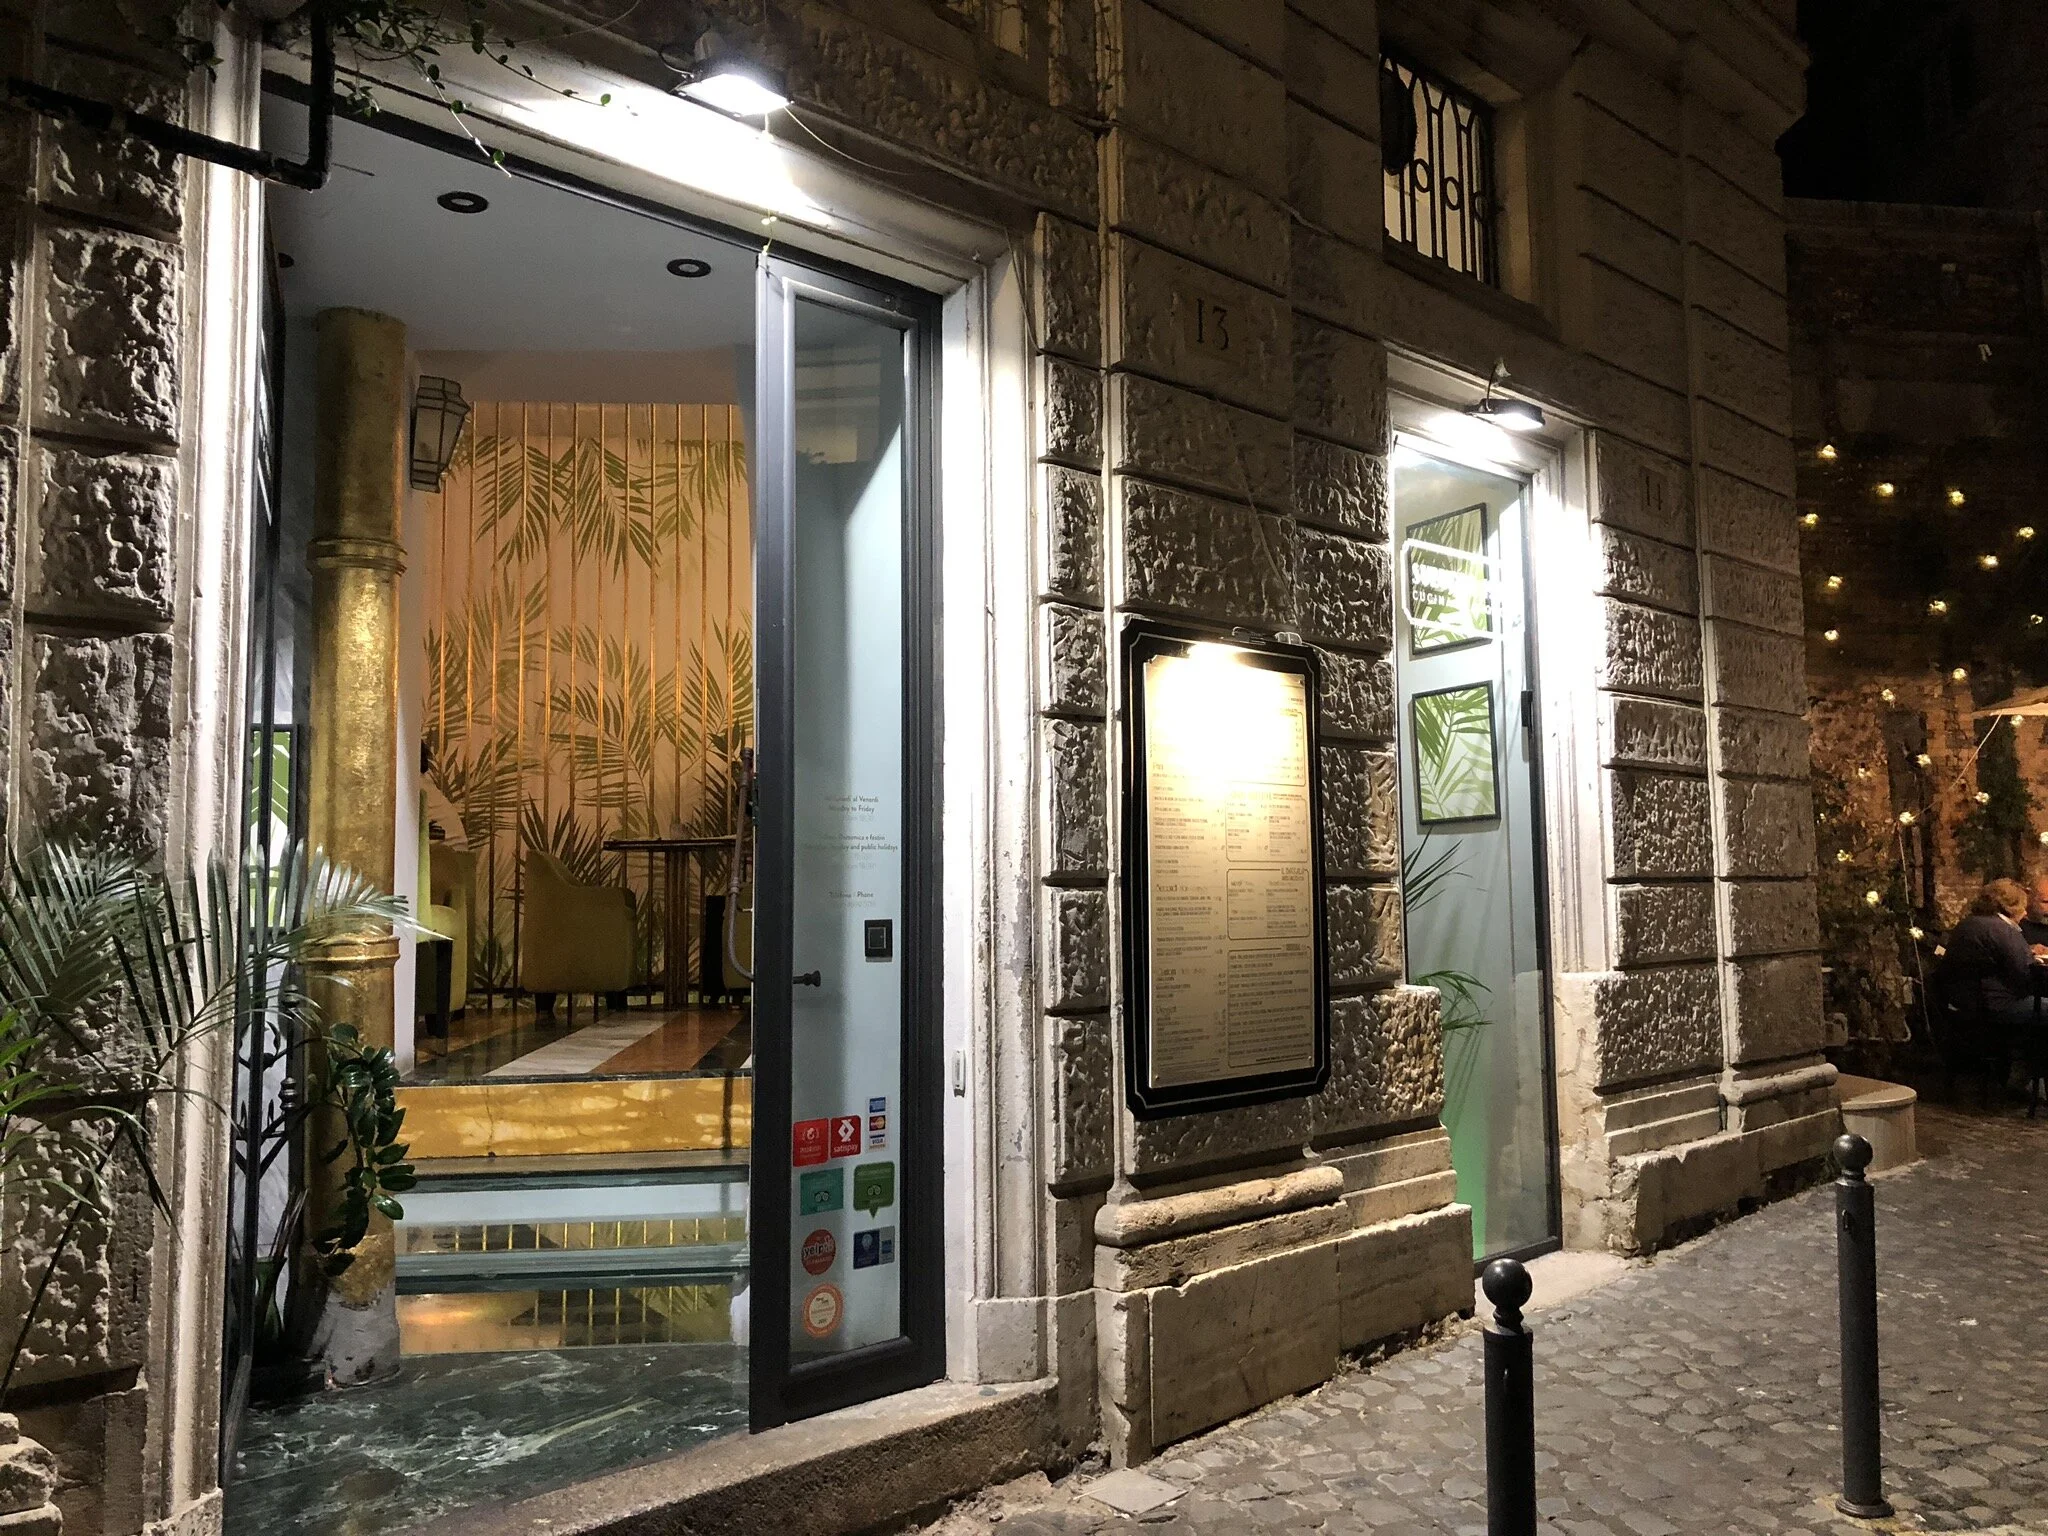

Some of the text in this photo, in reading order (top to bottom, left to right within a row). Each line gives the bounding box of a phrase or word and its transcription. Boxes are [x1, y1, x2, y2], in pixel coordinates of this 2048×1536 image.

[1196, 297, 1230, 351] 13
[1412, 590, 1450, 607] CUCIN
[858, 804, 875, 814] Friday
[860, 844, 877, 852] public
[833, 1143, 858, 1154] satispay
[803, 1243, 824, 1257] yelp
